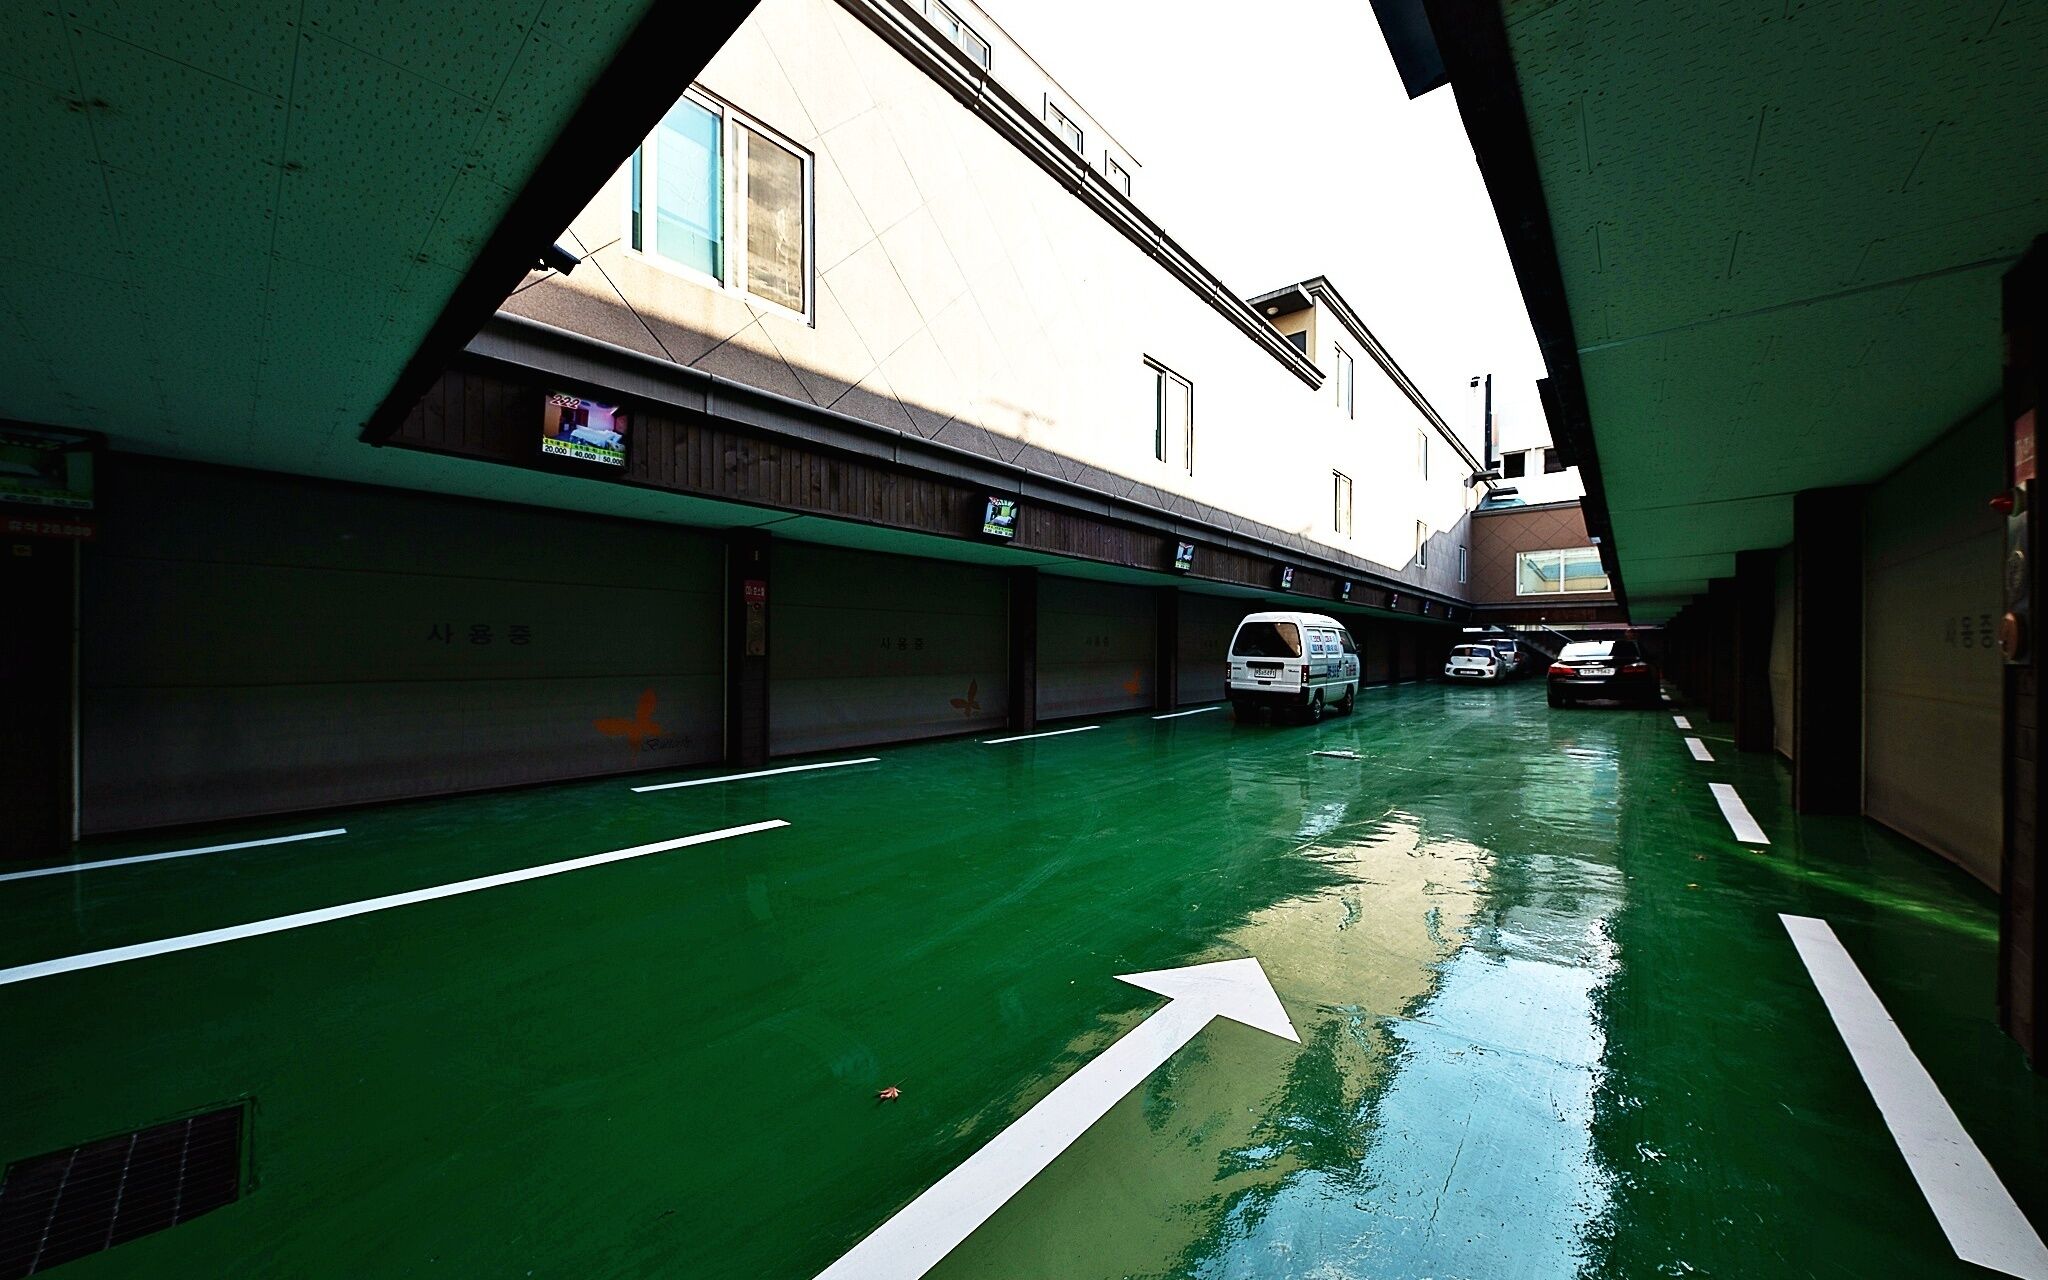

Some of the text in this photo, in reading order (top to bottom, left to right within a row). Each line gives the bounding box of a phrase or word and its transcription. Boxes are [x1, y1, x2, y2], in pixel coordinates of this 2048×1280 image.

[544, 445, 567, 455] 20,000
[574, 450, 596, 460] 40,000
[602, 456, 624, 466] 50,000
